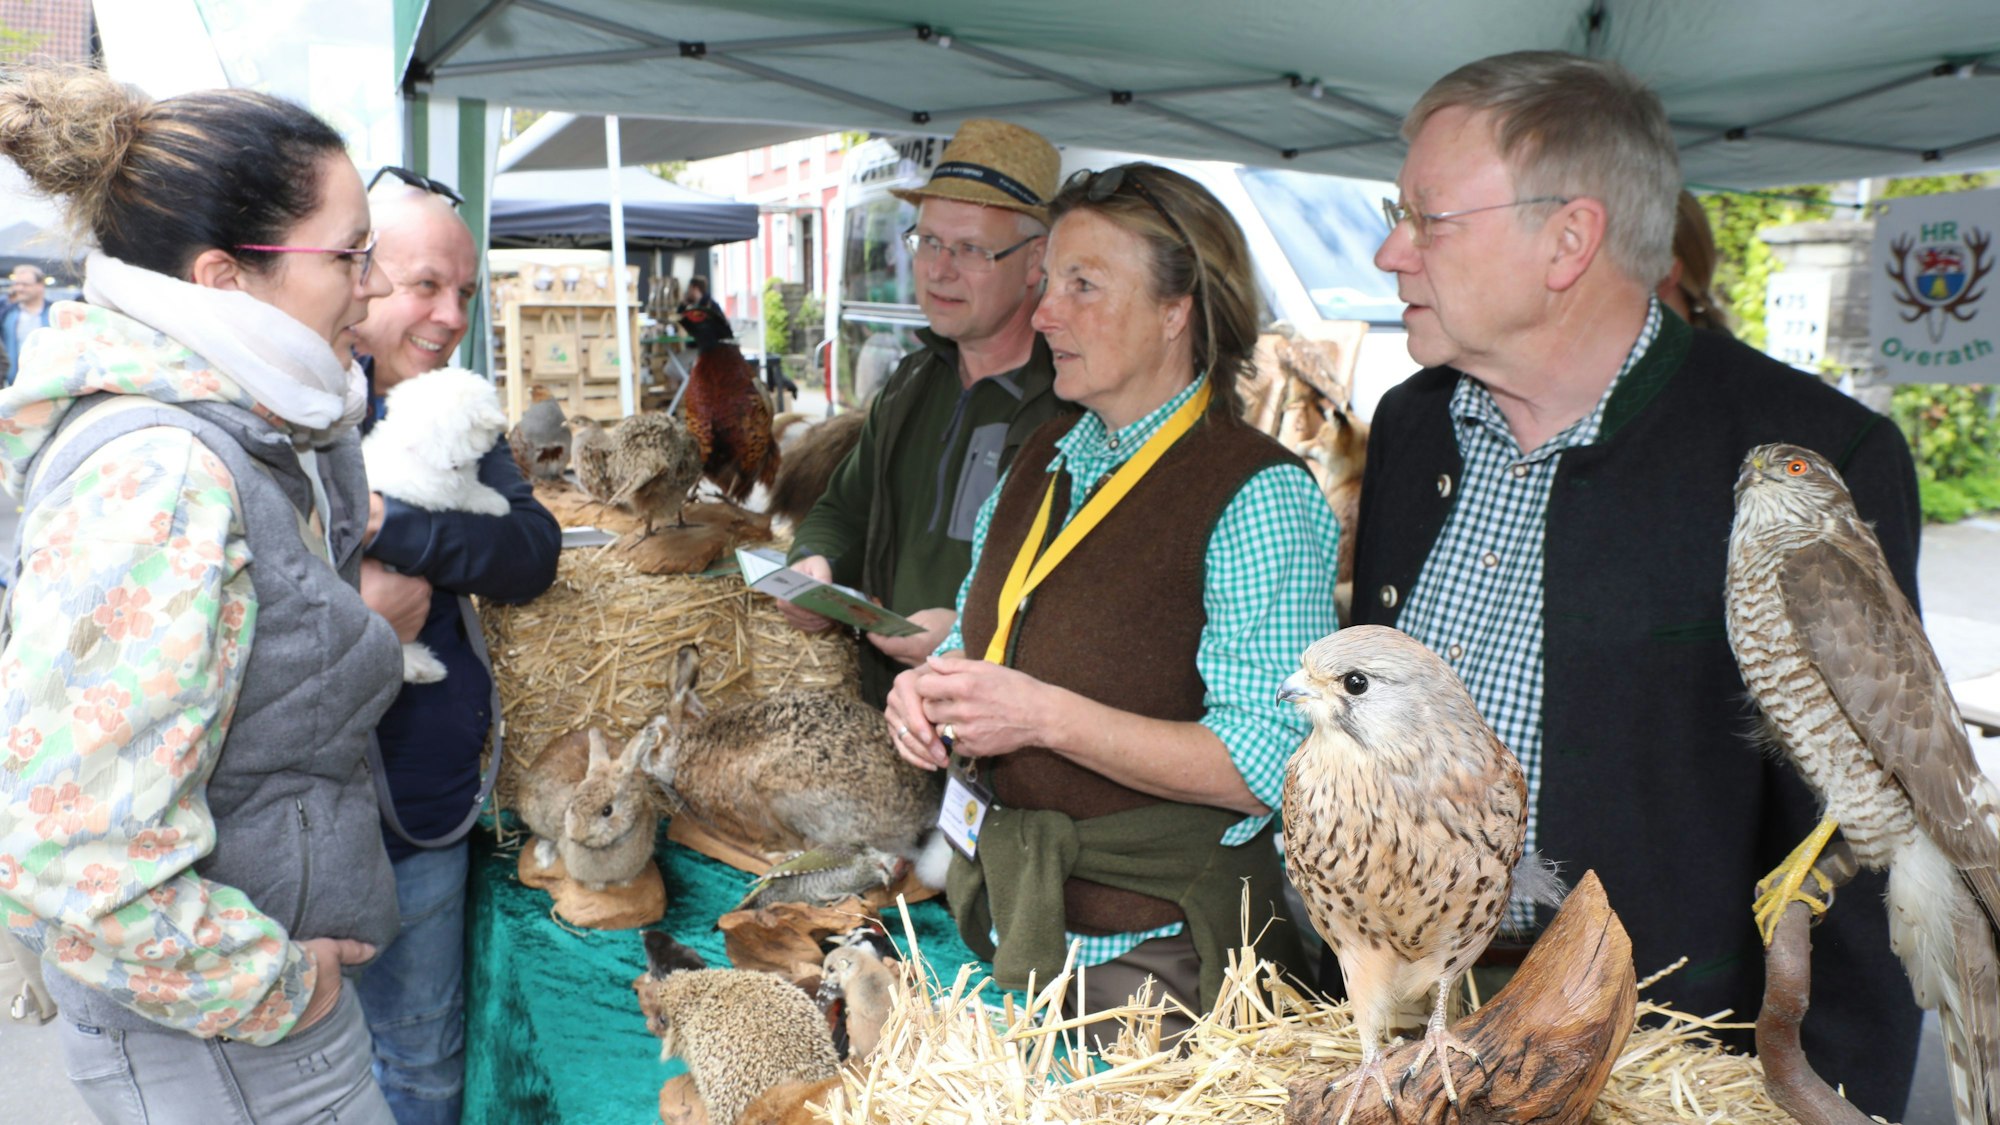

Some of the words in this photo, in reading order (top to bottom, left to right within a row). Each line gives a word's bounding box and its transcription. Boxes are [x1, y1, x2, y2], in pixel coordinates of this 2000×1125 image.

[1920, 221, 1959, 243] HR
[1786, 294, 1806, 310] 75
[1784, 320, 1805, 335] 77
[1881, 337, 1993, 366] Overath
